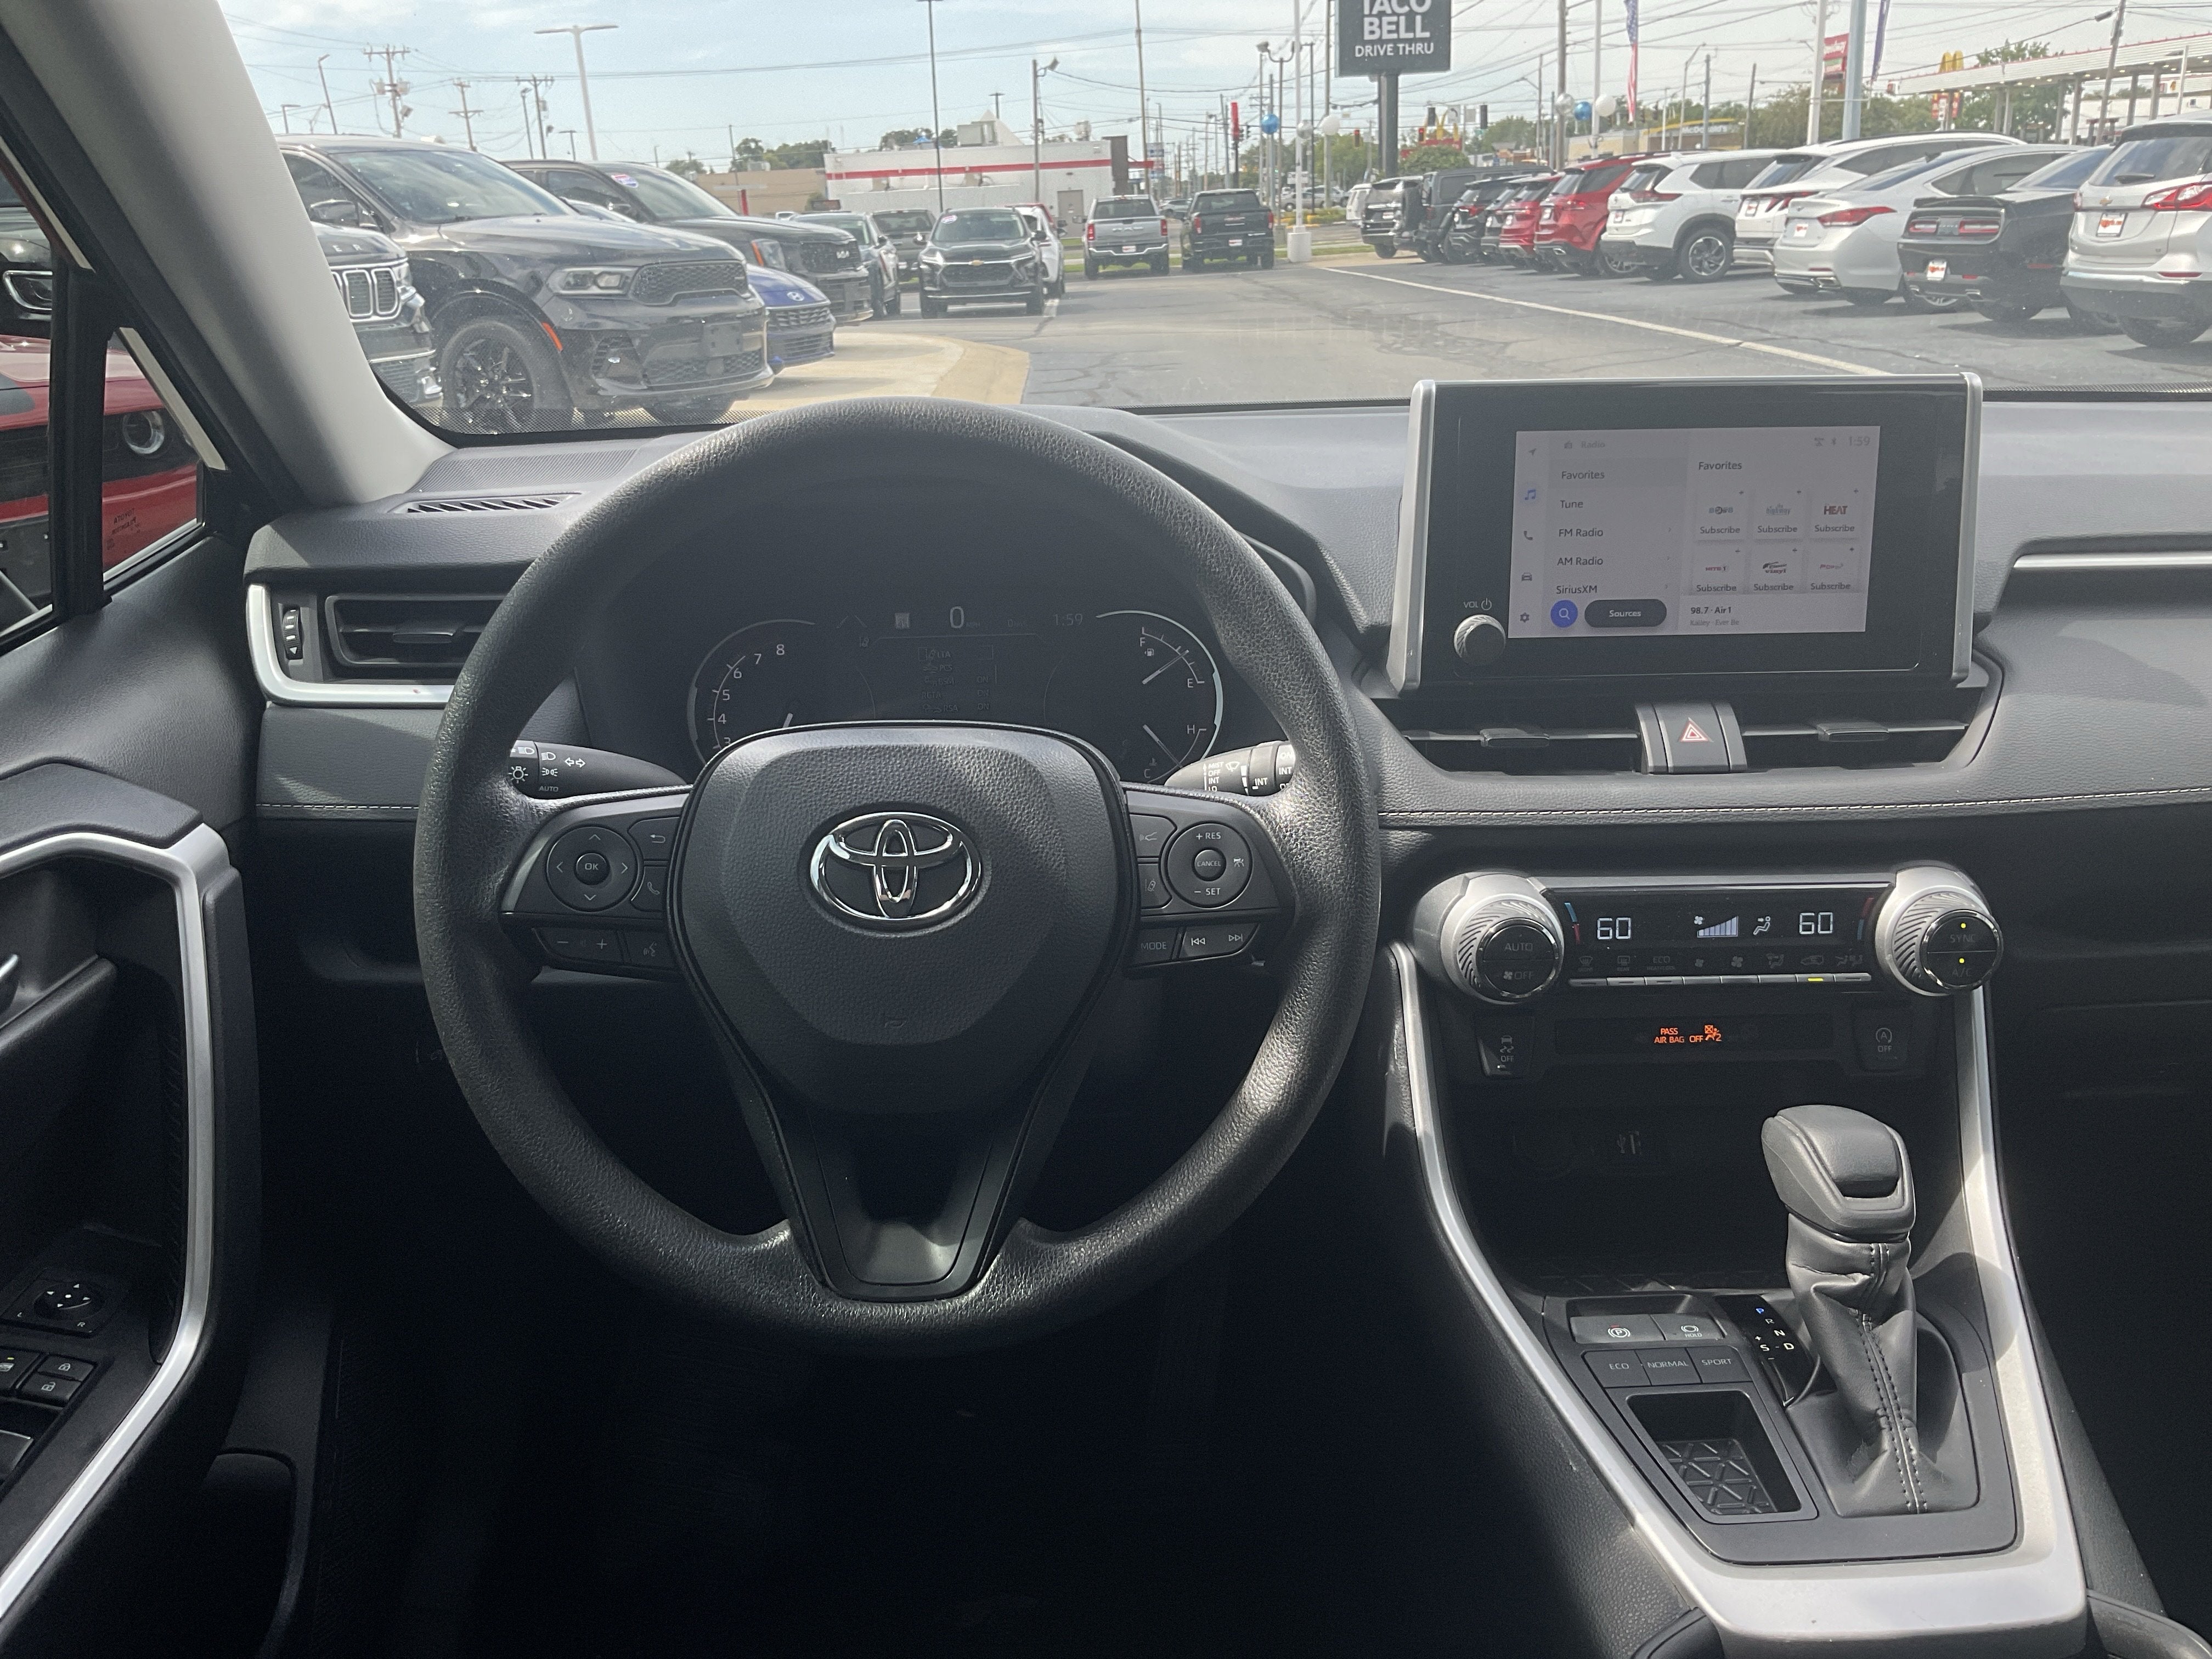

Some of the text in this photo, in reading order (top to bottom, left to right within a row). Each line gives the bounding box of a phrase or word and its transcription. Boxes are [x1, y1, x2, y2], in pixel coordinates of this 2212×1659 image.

[1363, 15, 1430, 40] BELL
[1355, 42, 1434, 57] DRIVE THRU
[1581, 441, 1605, 449] Radio
[1848, 436, 1870, 446] 1:59
[1699, 460, 1742, 470] Favorites
[1561, 470, 1605, 480] Favorites
[1560, 500, 1583, 509] Tune
[1824, 505, 1848, 515] HEAT
[1559, 528, 1603, 537] FM Radio
[1700, 526, 1741, 535] Subscribe
[1757, 525, 1798, 533] Subscribe
[1814, 524, 1855, 532] Subscribe
[1557, 557, 1603, 566] AM Radio
[1556, 584, 1598, 594] SiriusXM
[1810, 582, 1851, 590] Subscribe
[1690, 606, 1709, 614] 98.7
[950, 606, 965, 629] 0
[1053, 613, 1084, 627] 1:59
[1139, 637, 1147, 647] F
[776, 644, 785, 656] 8
[754, 653, 762, 664] 7
[939, 664, 953, 672] PCS
[733, 668, 742, 679] 6
[1187, 678, 1194, 688] E
[722, 689, 730, 701] 5
[718, 713, 727, 725] 4
[1187, 724, 1196, 735] H
[1143, 768, 1152, 779] C
[1279, 766, 1292, 775] INT
[1255, 777, 1268, 786] INT
[585, 862, 599, 871] OK
[1205, 888, 1221, 896] SET
[1597, 917, 1632, 940] 60
[1799, 912, 1834, 935] 60
[1949, 934, 1976, 943] SYNC
[1141, 941, 1167, 950] MODE
[1504, 942, 1533, 952] AUTO
[1653, 956, 1671, 964] ECO
[1514, 970, 1534, 980] OFF
[1951, 967, 1972, 977] A/C
[1877, 1045, 1892, 1053] OFF
[1500, 1054, 1514, 1063] OFF
[1647, 1360, 1689, 1369] NORMAL
[1701, 1358, 1732, 1366] SPORT
